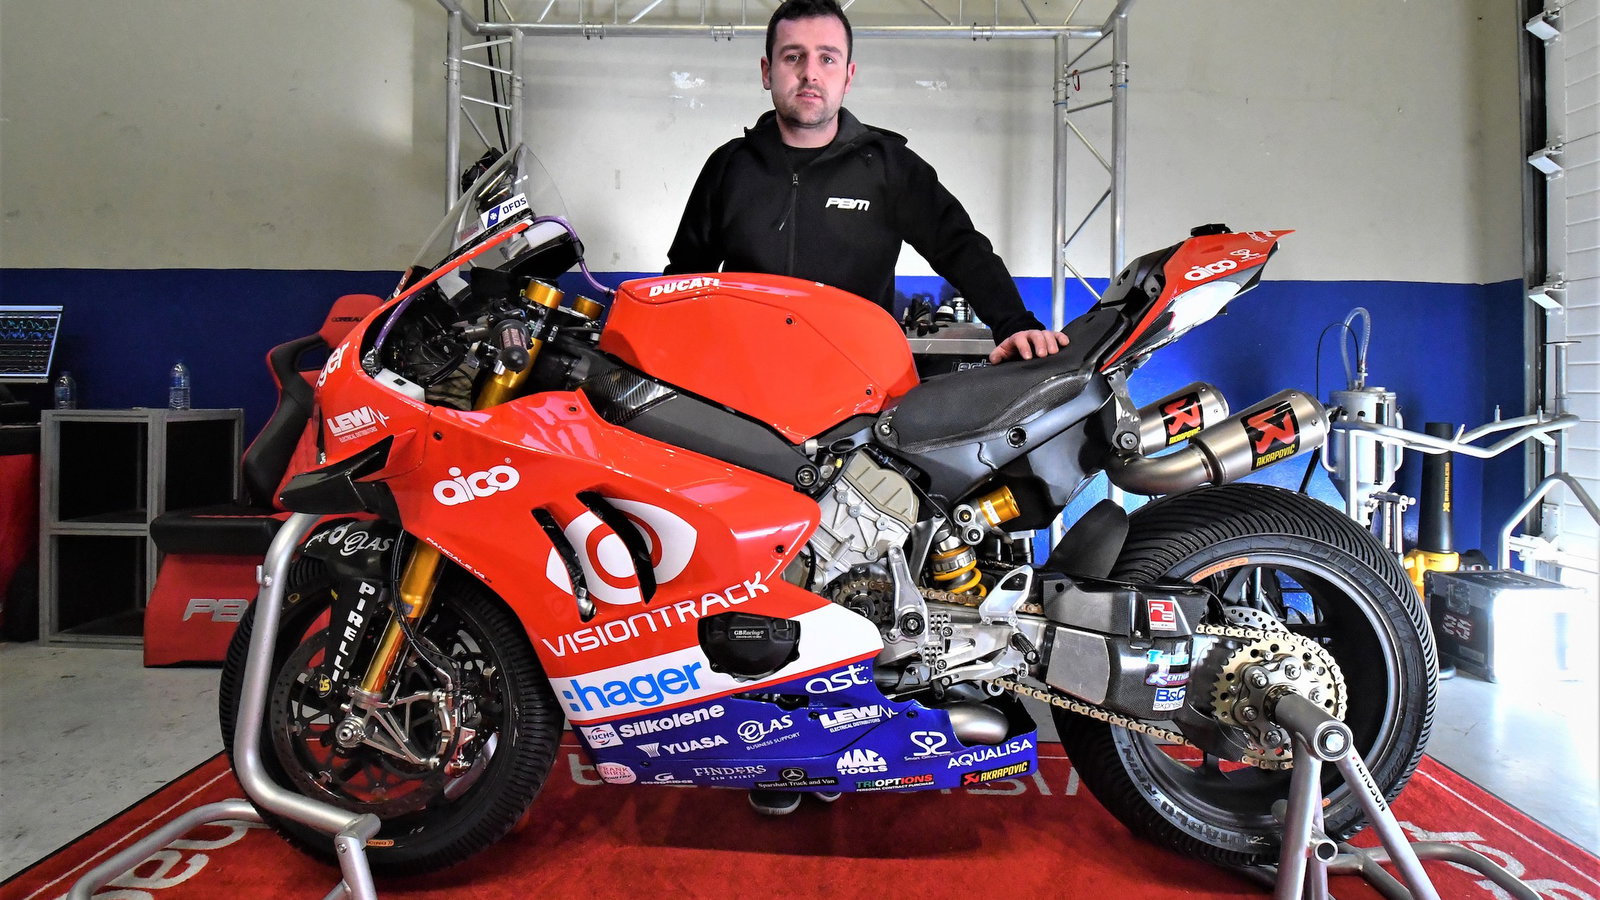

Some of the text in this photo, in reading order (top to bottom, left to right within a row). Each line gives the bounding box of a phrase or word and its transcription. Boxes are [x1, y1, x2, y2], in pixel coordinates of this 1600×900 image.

[502, 196, 527, 215] DFDS
[825, 197, 870, 211] PBM
[1184, 259, 1238, 281] aico
[649, 277, 720, 297] DUCATI
[314, 341, 350, 388] ger
[327, 405, 376, 437] LEW
[1256, 443, 1295, 467] AKRAPOVIC
[433, 466, 520, 506] aico
[426, 537, 473, 571] PANIGALE
[182, 598, 249, 622] PB
[542, 571, 770, 658] VISIONTRACK
[332, 581, 376, 682] PIRELLI
[619, 704, 725, 738] Silkolene
[819, 705, 882, 729] LEW
[587, 730, 615, 741] FUCHS
[661, 734, 729, 755] YUASA
[746, 732, 800, 751] BUSINESS SUPPORT
[836, 748, 887, 770] MAC
[947, 739, 1033, 769] AQUALISA
[692, 764, 767, 777] FINDERS
[837, 766, 888, 775] TOOLS
[856, 774, 933, 788] TRIOPTIONS
[980, 761, 1028, 782] AKRAPOVIC
